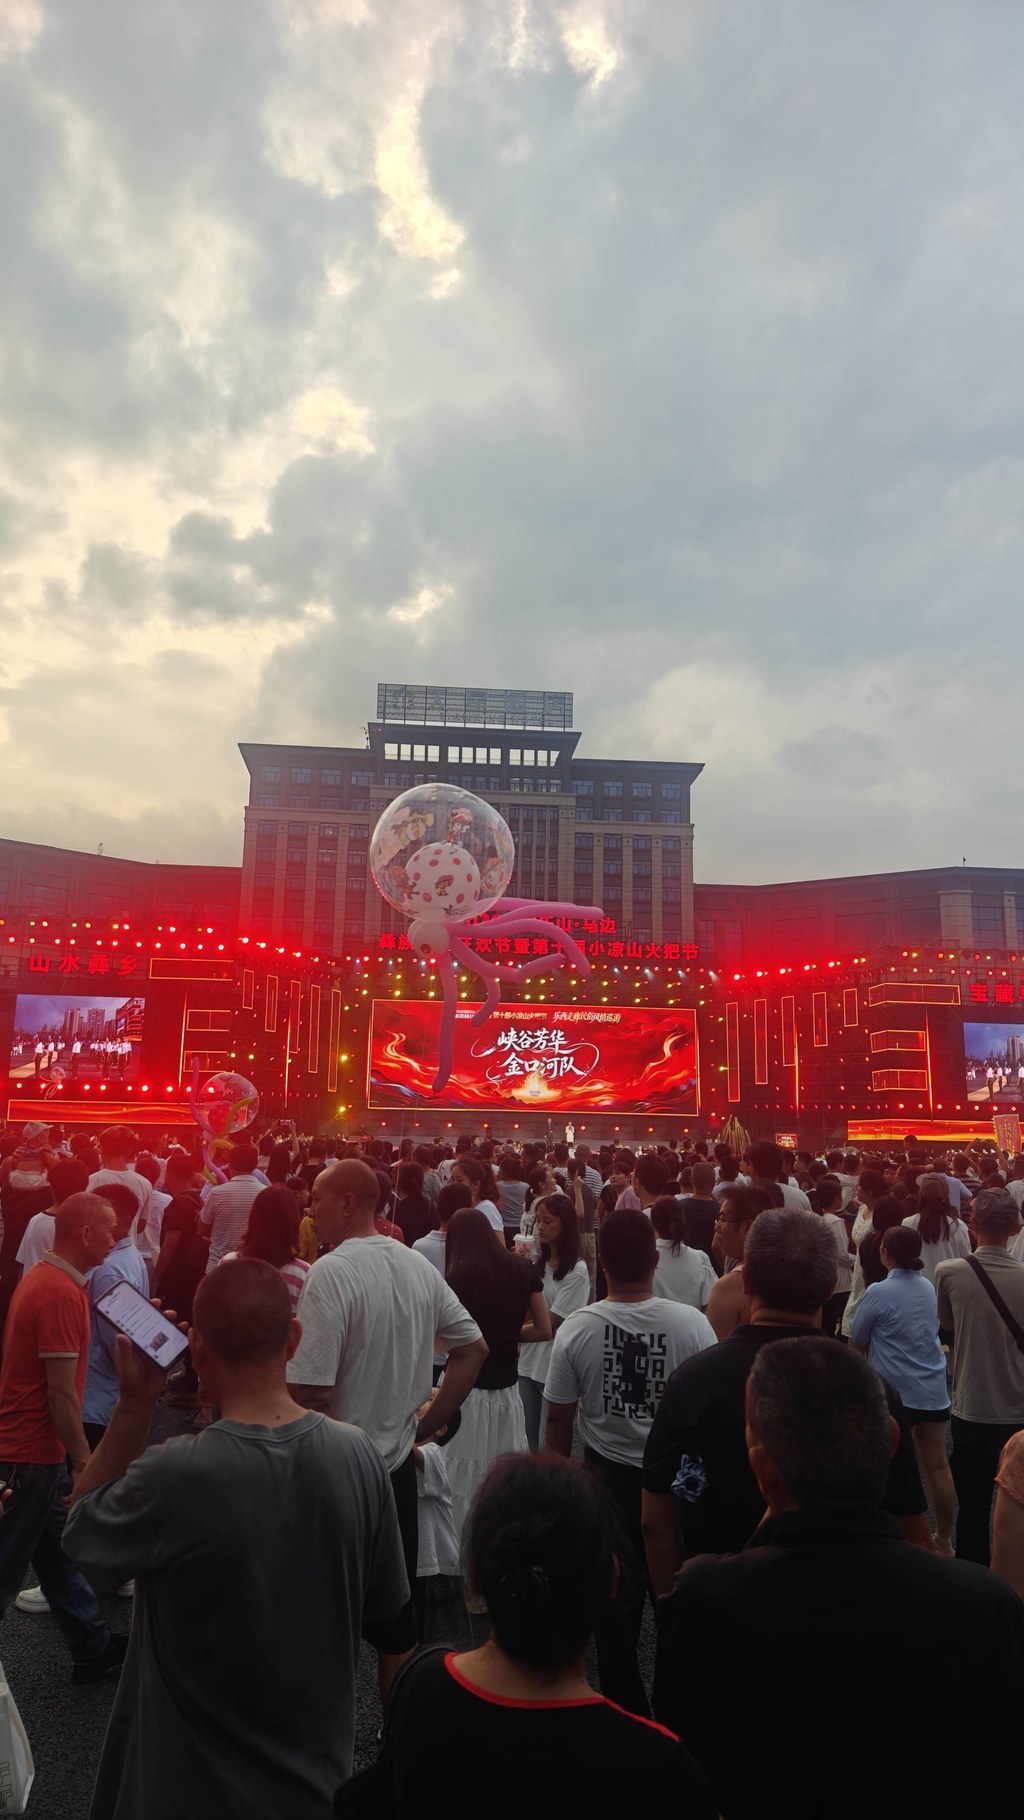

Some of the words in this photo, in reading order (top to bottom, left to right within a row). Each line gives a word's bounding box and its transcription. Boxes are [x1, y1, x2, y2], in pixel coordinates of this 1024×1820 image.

[378, 932, 699, 961] 彝族欢节暨第十小凉山火把节
[29, 952, 139, 976] 山水彝乡
[969, 982, 1024, 1004] 宝藏
[497, 1027, 570, 1055] 峡谷芳华
[497, 1052, 587, 1078] 金口河队
